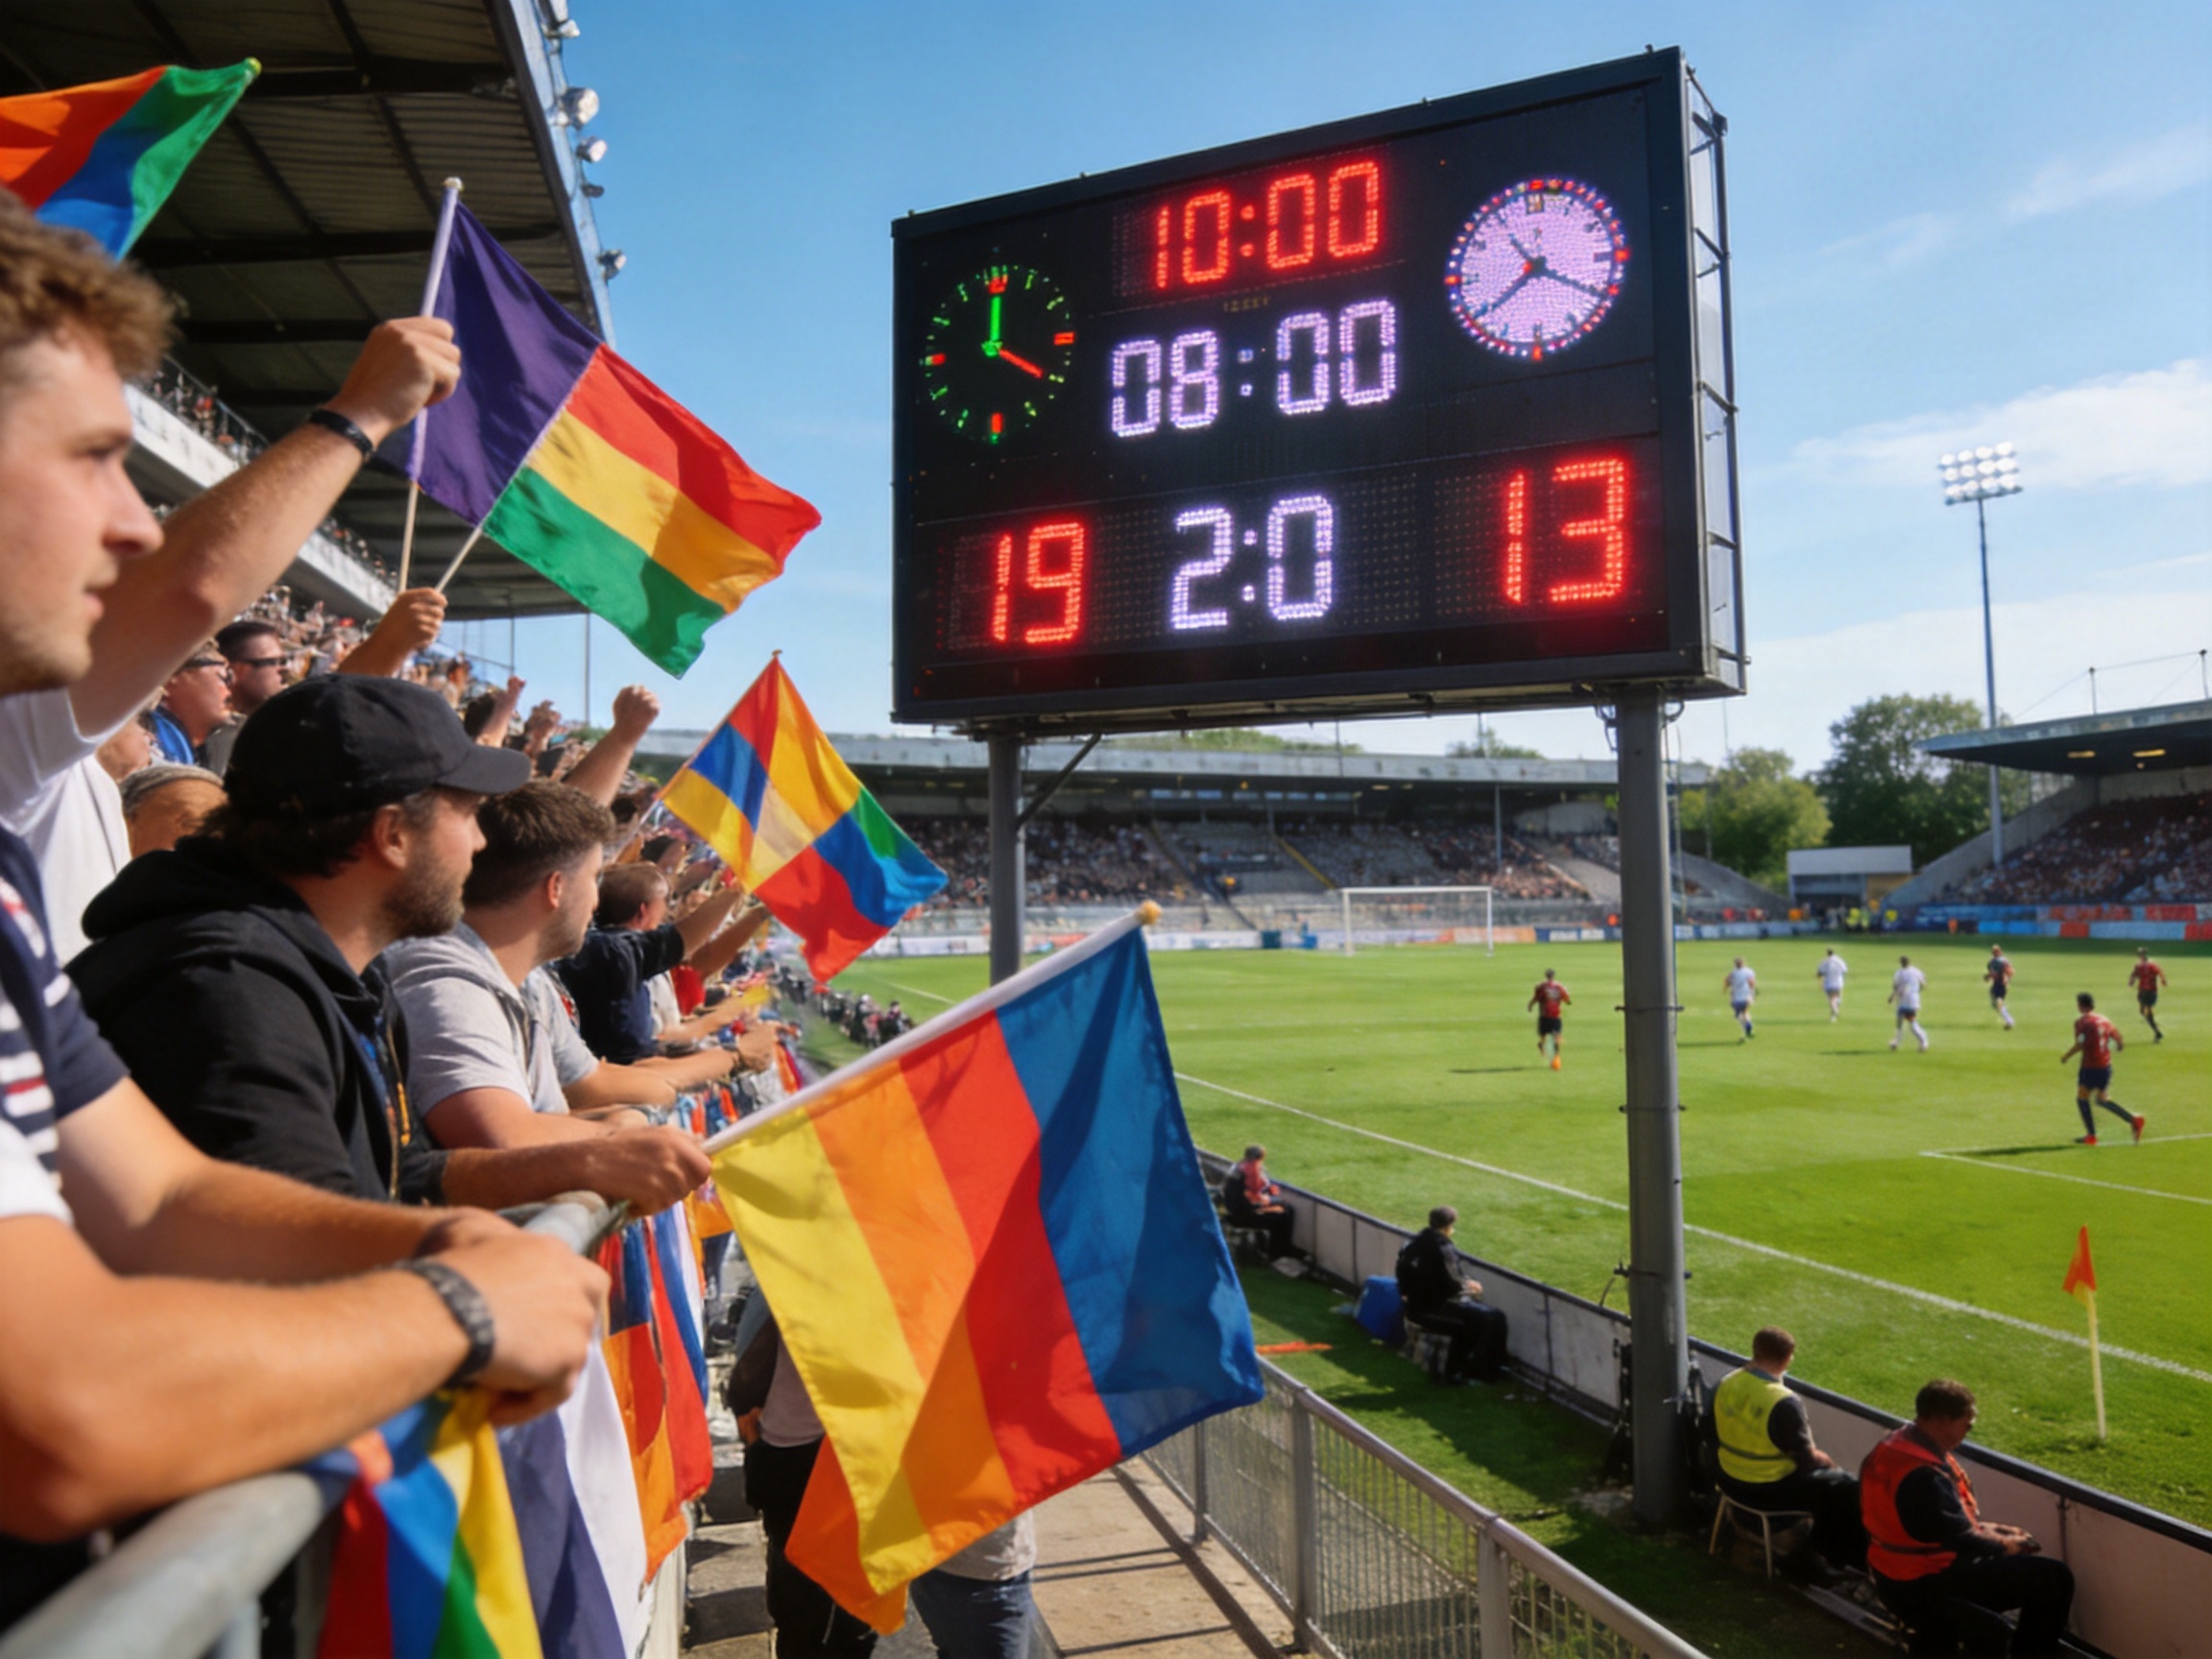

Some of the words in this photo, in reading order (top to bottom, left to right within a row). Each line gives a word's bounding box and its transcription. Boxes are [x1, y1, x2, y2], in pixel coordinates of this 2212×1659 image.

[1155, 159, 1382, 289] 10:00
[1111, 300, 1397, 438] 08:00
[990, 519, 1087, 646] 19
[1169, 493, 1334, 631] 2:0
[1501, 454, 1631, 606] 13
